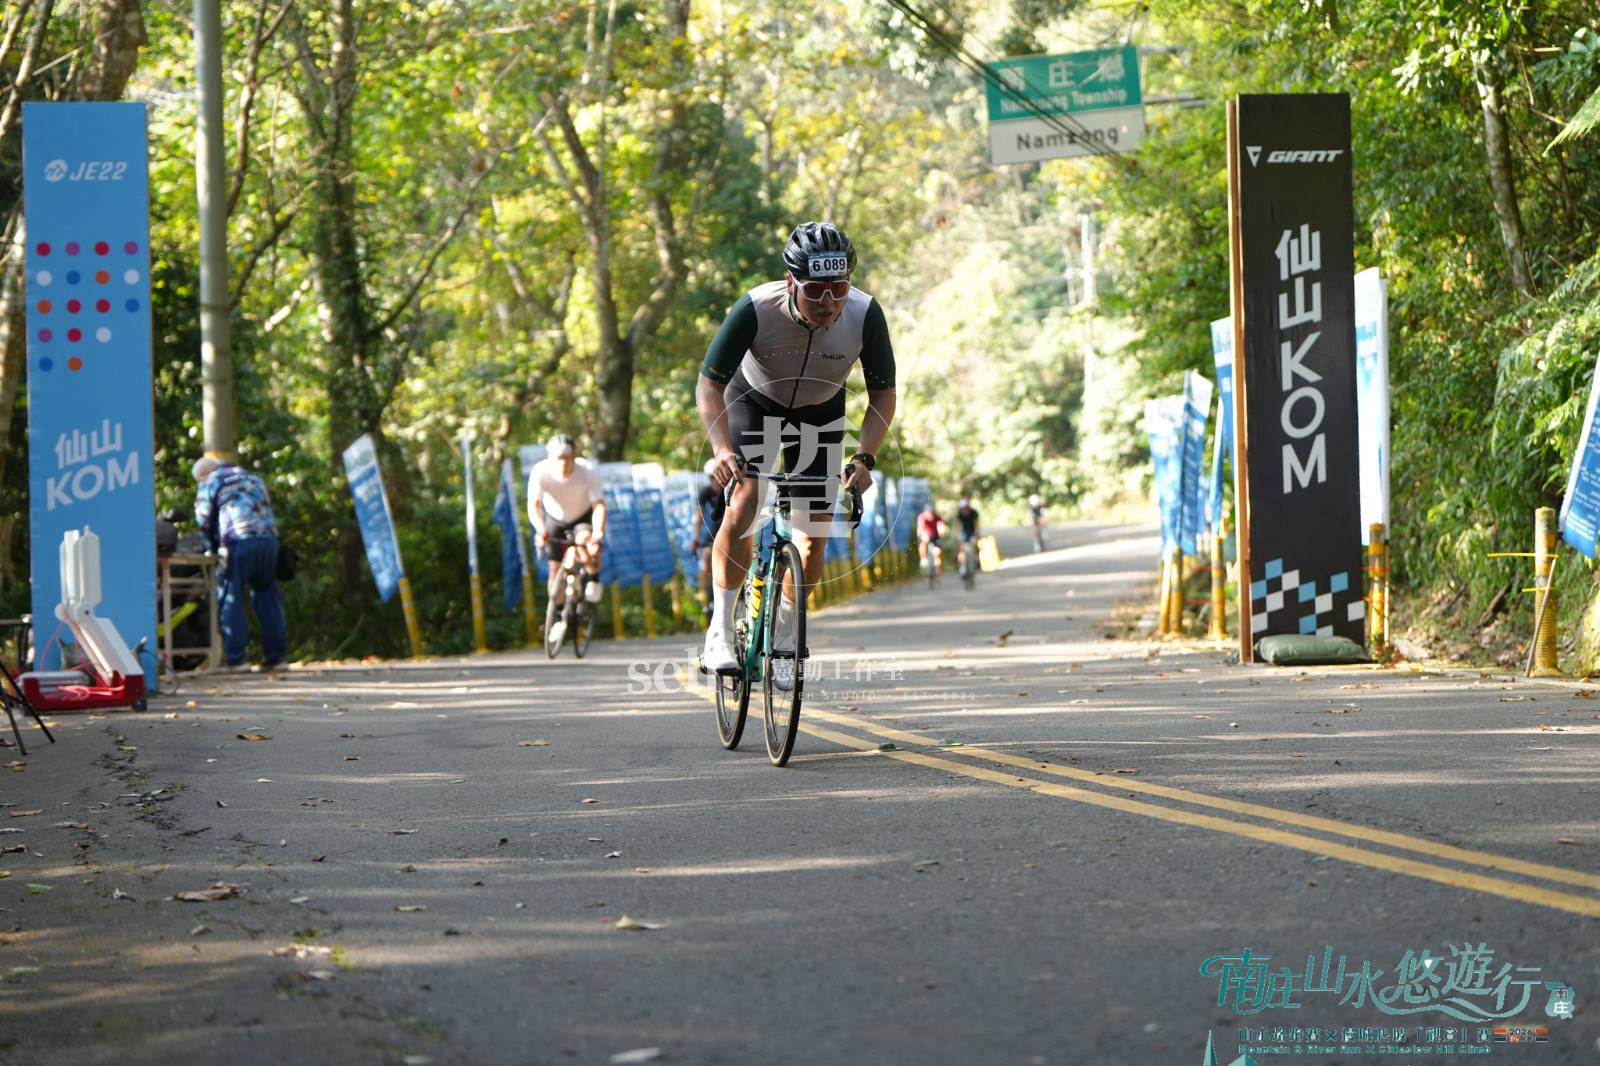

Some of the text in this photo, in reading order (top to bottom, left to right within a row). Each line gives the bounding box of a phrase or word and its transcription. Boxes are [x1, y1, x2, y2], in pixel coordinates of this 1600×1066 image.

[69, 160, 129, 182] JE22
[1266, 149, 1345, 164] GIANT
[1280, 331, 1328, 496] KOM
[54, 418, 122, 471] 仙山
[46, 450, 139, 512] KOM
